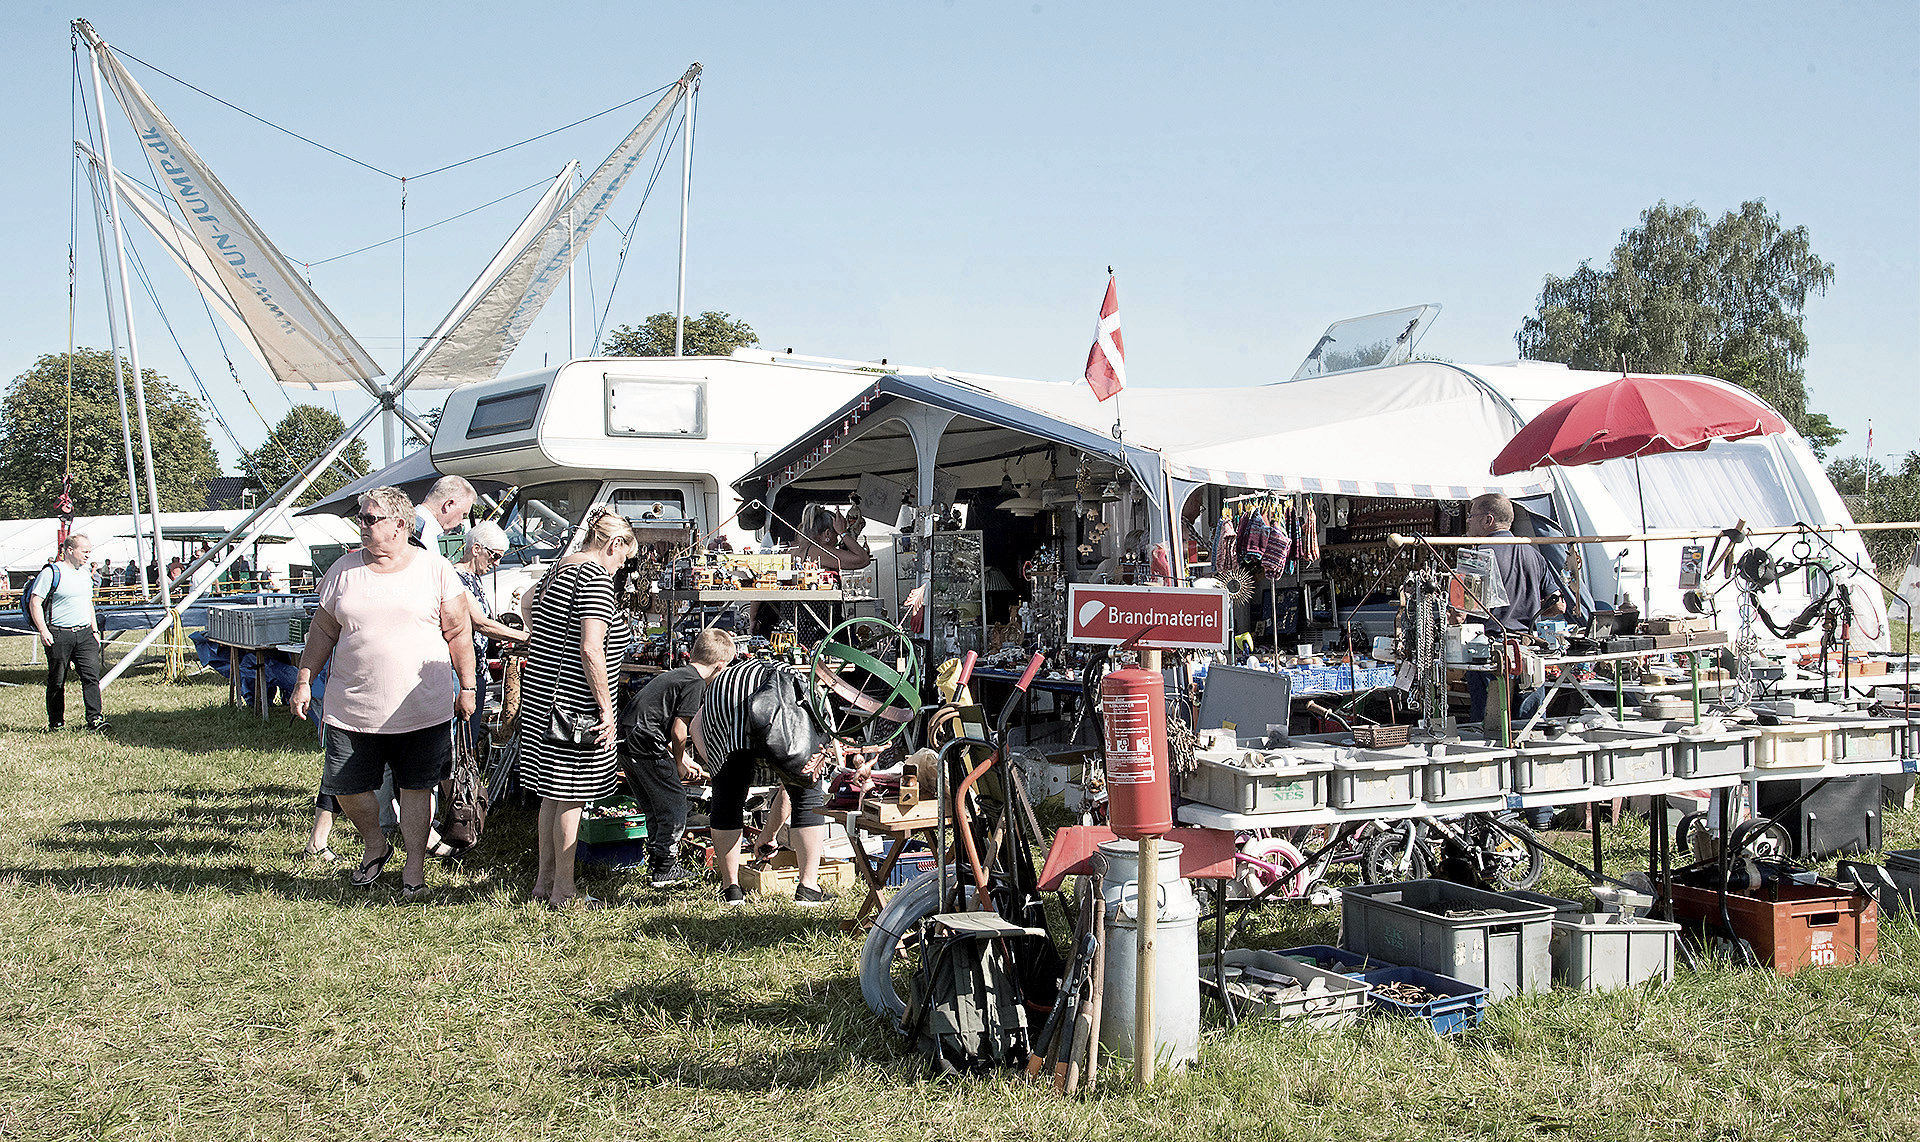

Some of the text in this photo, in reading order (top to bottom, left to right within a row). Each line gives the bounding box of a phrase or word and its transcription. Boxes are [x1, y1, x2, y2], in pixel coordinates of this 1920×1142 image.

[140, 126, 296, 335] www.FUN-JUMP.dk
[1109, 606, 1218, 627] Brandmateriel
[1272, 791, 1304, 802] NES
[1811, 949, 1834, 966] HD
